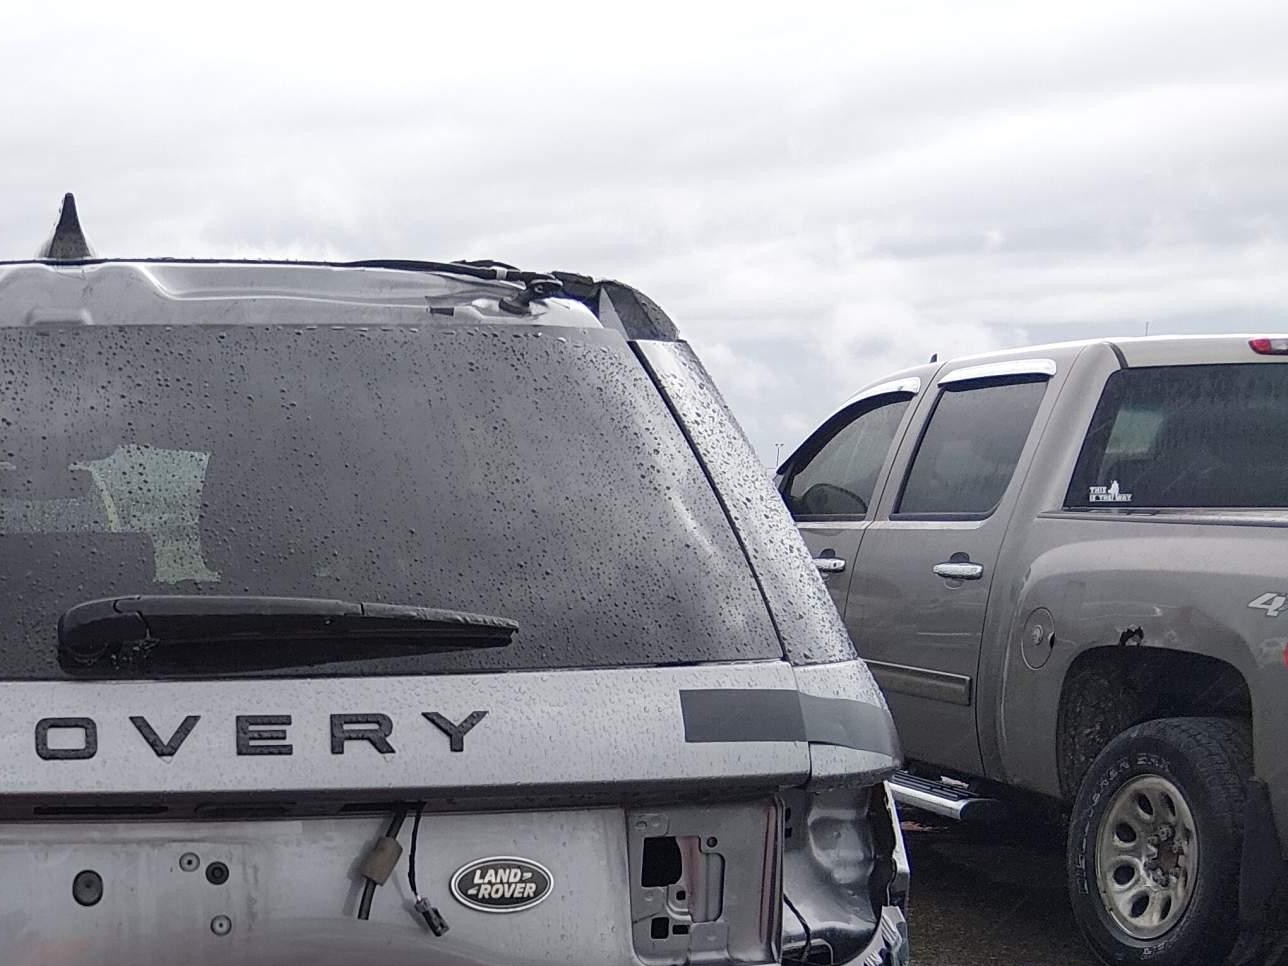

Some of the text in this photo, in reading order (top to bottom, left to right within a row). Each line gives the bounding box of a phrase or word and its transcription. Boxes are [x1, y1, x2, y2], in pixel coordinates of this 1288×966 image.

[1247, 592, 1288, 617] 4
[473, 868, 521, 884] LAND
[478, 882, 536, 899] ROVER
